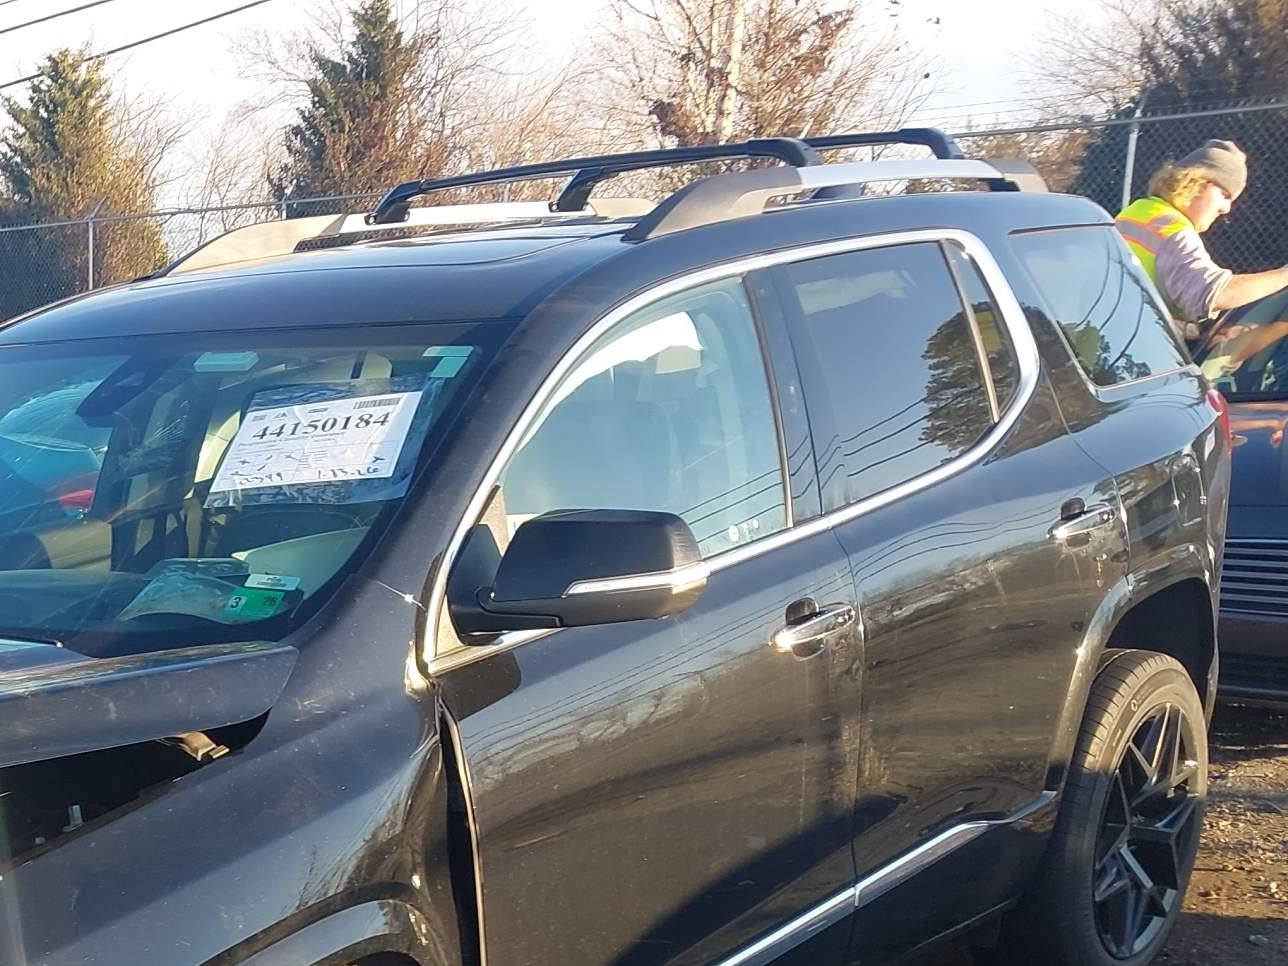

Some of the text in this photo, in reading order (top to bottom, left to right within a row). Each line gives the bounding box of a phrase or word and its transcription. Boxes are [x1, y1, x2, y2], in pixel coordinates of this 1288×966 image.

[253, 411, 391, 440] 44150184
[230, 595, 278, 609] 3 26
